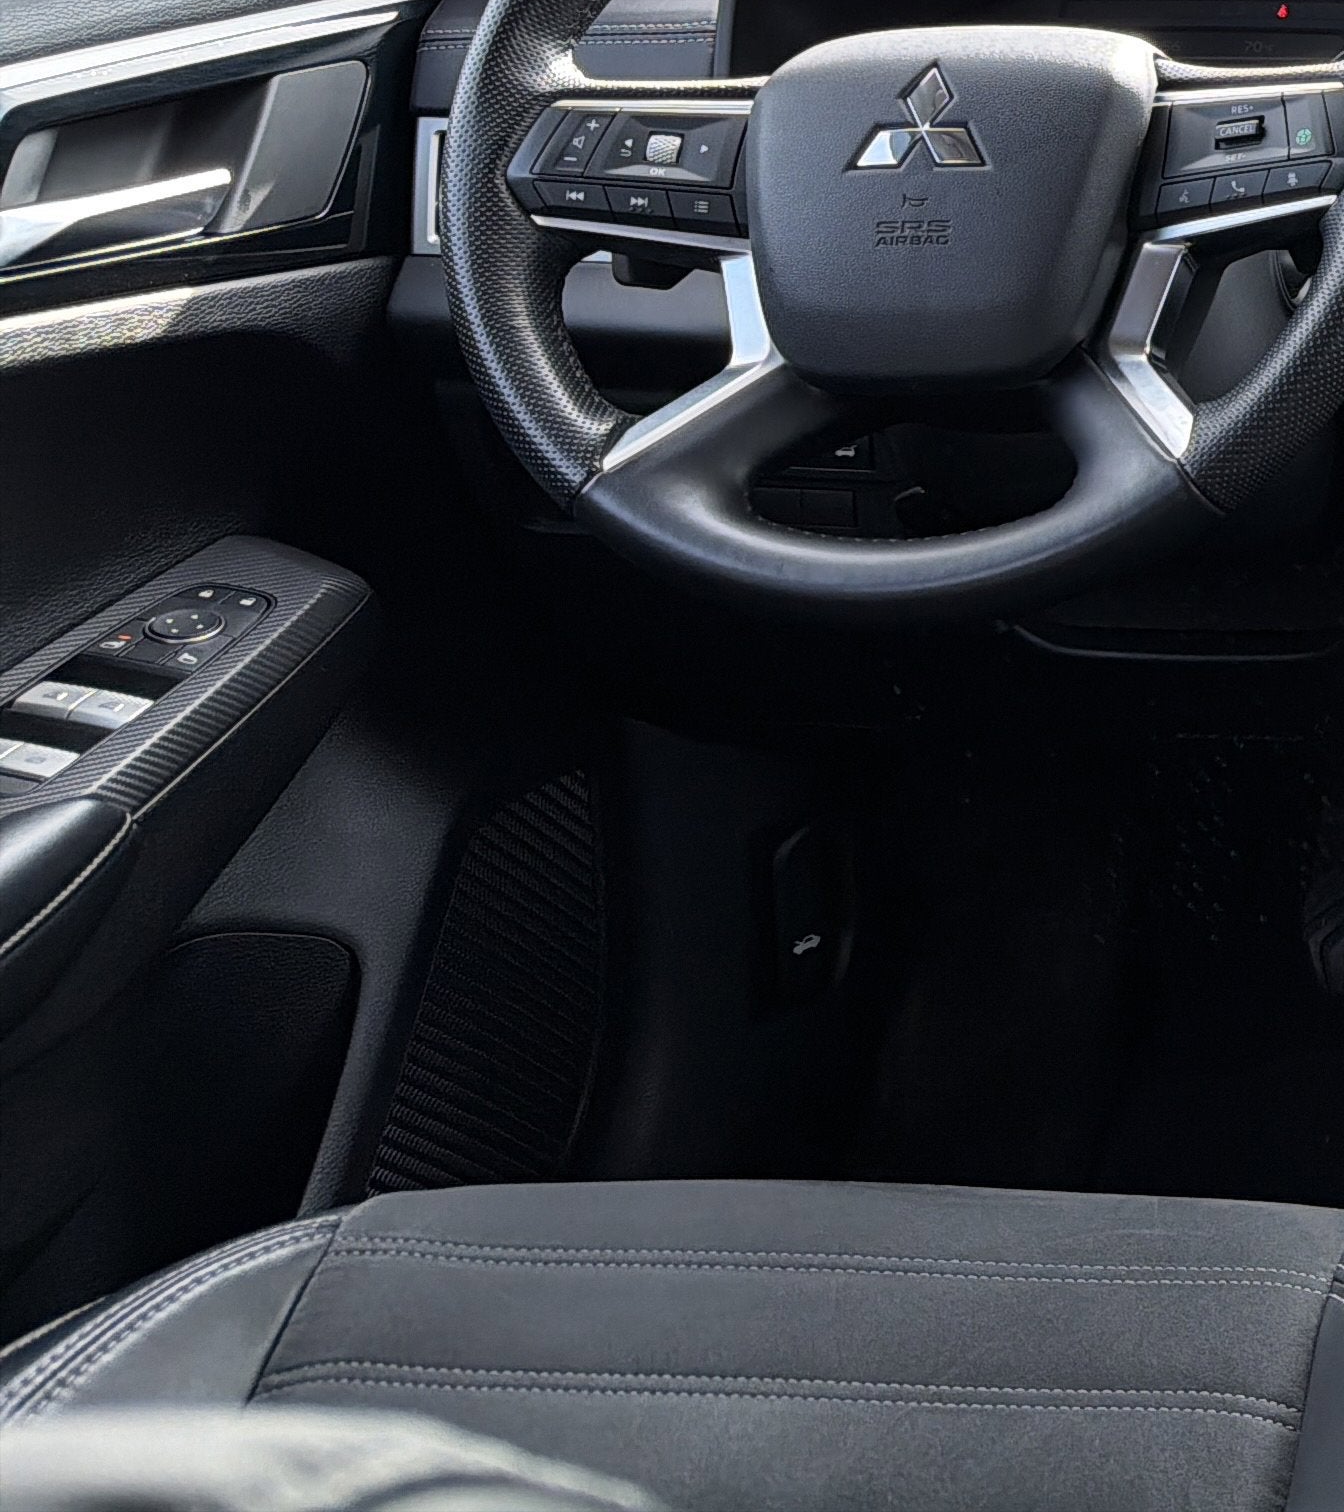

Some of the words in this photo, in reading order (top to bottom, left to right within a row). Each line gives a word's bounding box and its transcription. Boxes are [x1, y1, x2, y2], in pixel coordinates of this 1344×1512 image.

[1230, 104, 1254, 115] RES+
[1219, 125, 1256, 137] CANCEL
[649, 167, 666, 177] OK
[874, 218, 952, 236] SRS
[874, 235, 951, 248] AIRBAG
